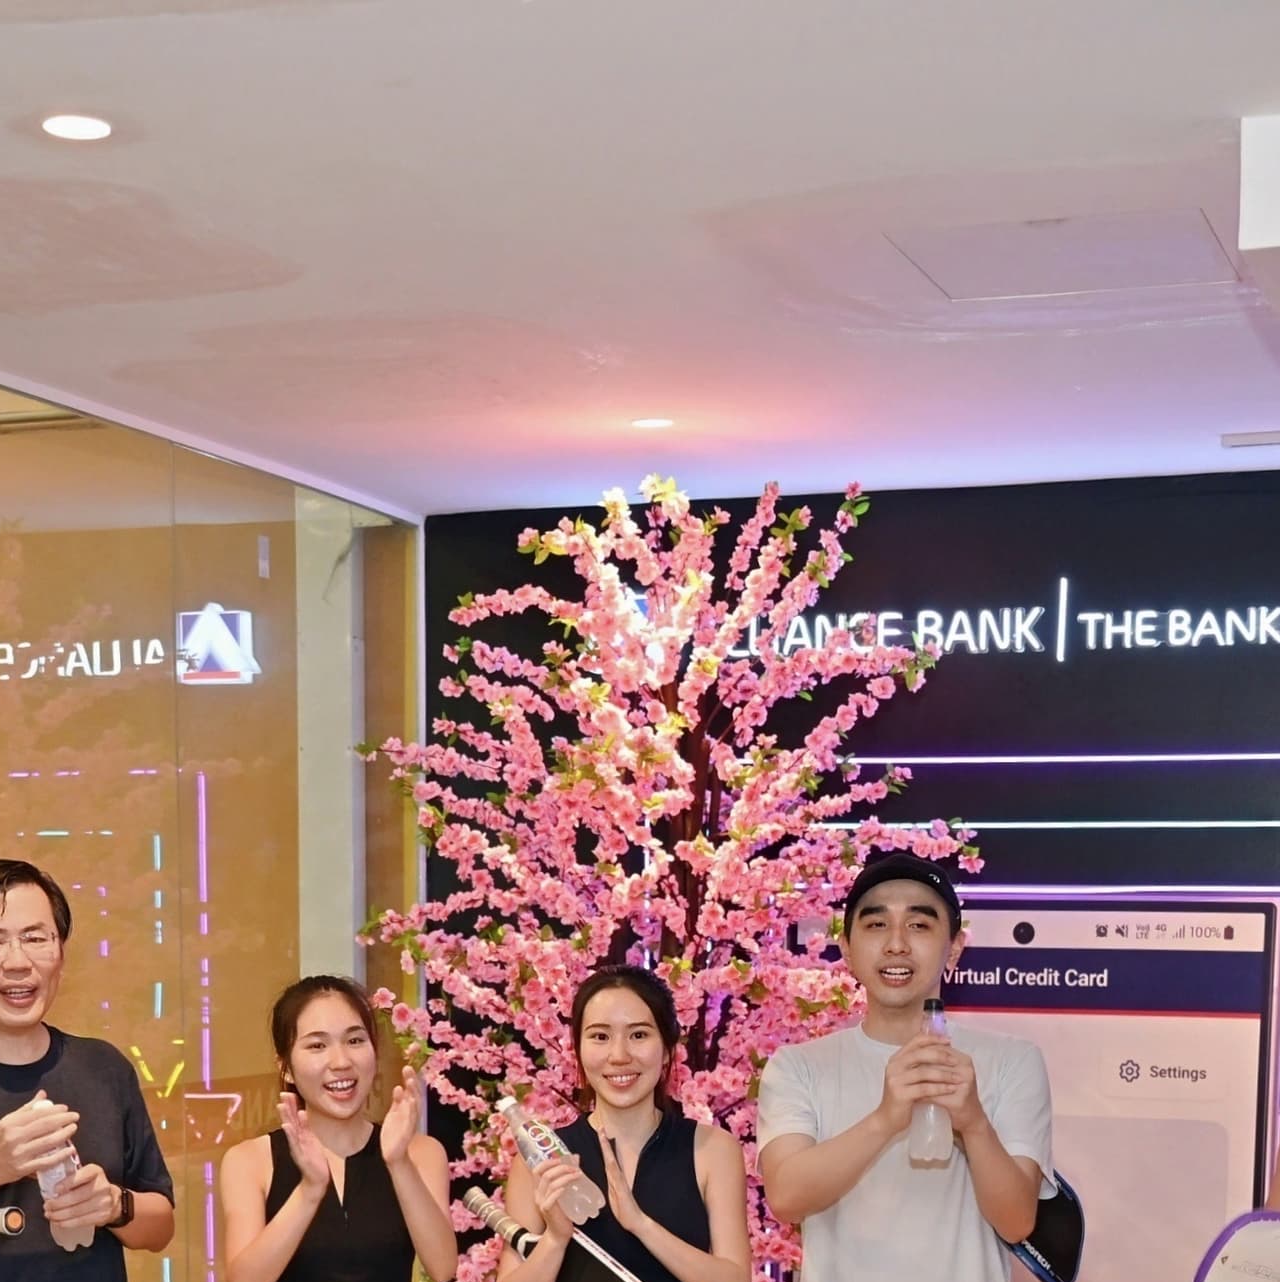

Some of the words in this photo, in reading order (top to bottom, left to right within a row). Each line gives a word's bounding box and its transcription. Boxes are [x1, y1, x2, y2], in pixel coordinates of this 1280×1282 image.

[915, 606, 1046, 655] BANK
[1077, 609, 1157, 650] THE
[1155, 924, 1167, 932] 4G
[1190, 926, 1220, 939] 100%
[942, 967, 1000, 985] Virtual
[1005, 968, 1060, 986] Credit
[1065, 968, 1108, 987] Card
[1150, 1065, 1207, 1081] Settings
